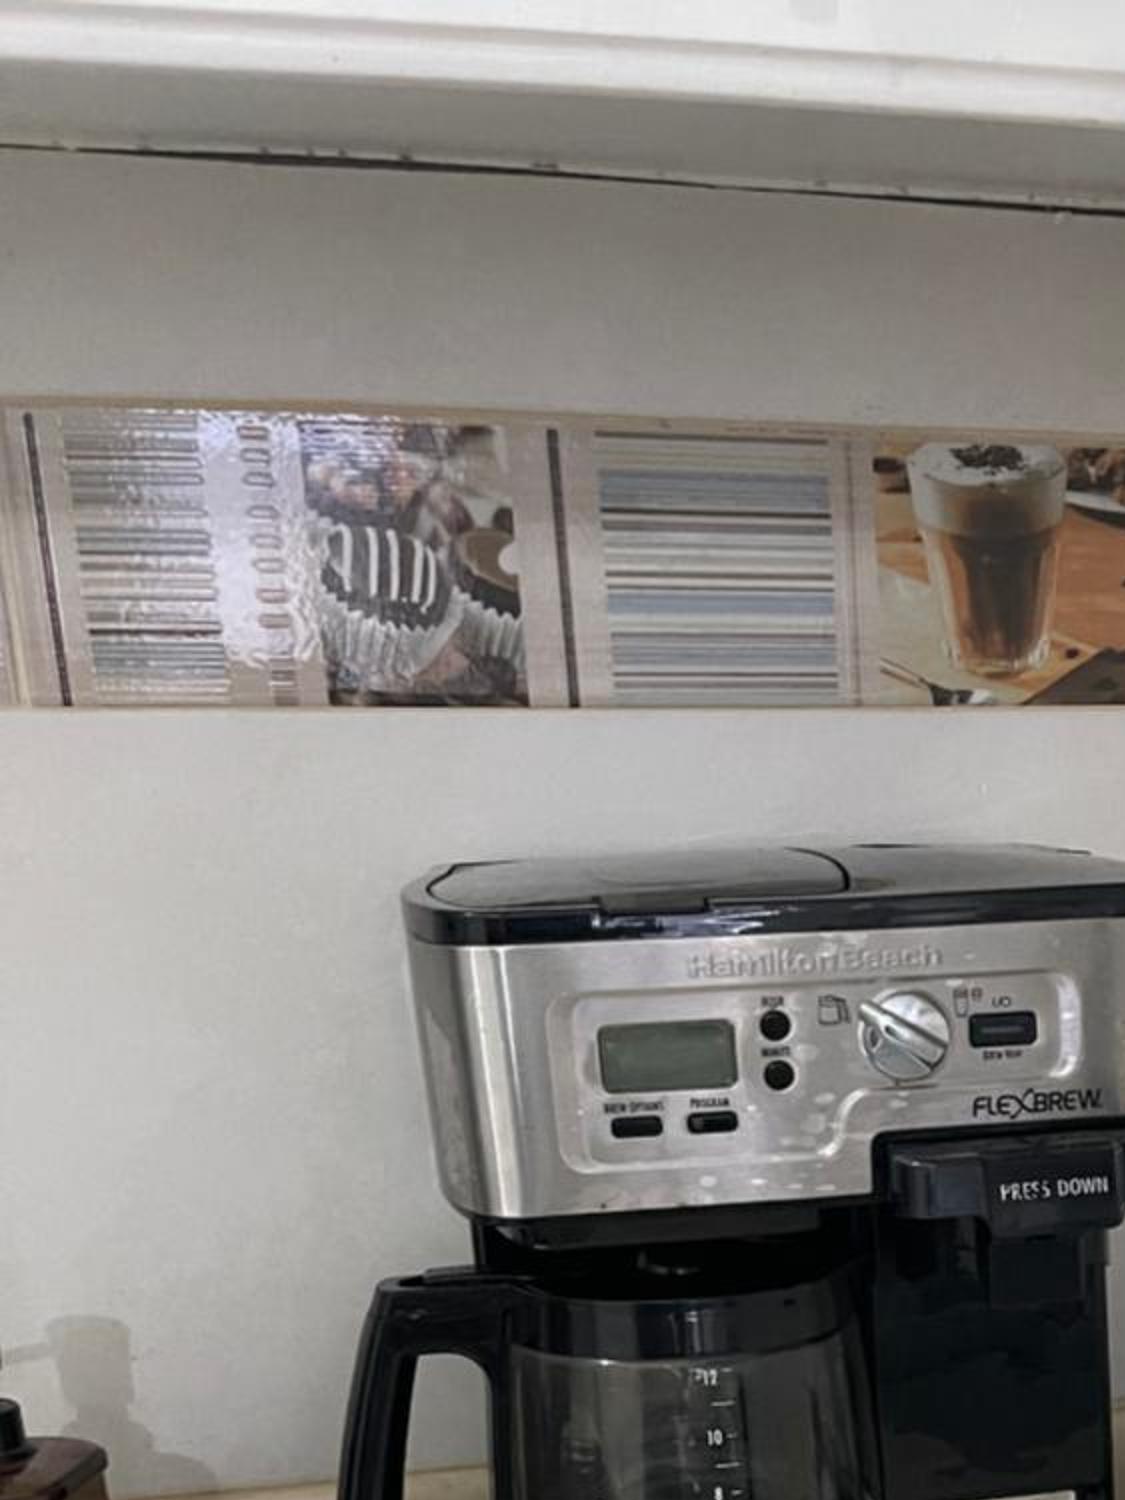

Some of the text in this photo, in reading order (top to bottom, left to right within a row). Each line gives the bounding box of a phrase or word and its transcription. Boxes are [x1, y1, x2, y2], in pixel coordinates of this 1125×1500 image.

[687, 945, 943, 978] Hamilton Beach
[1000, 1176, 1109, 1201] PRESS DOWN
[707, 1429, 723, 1446] 10
